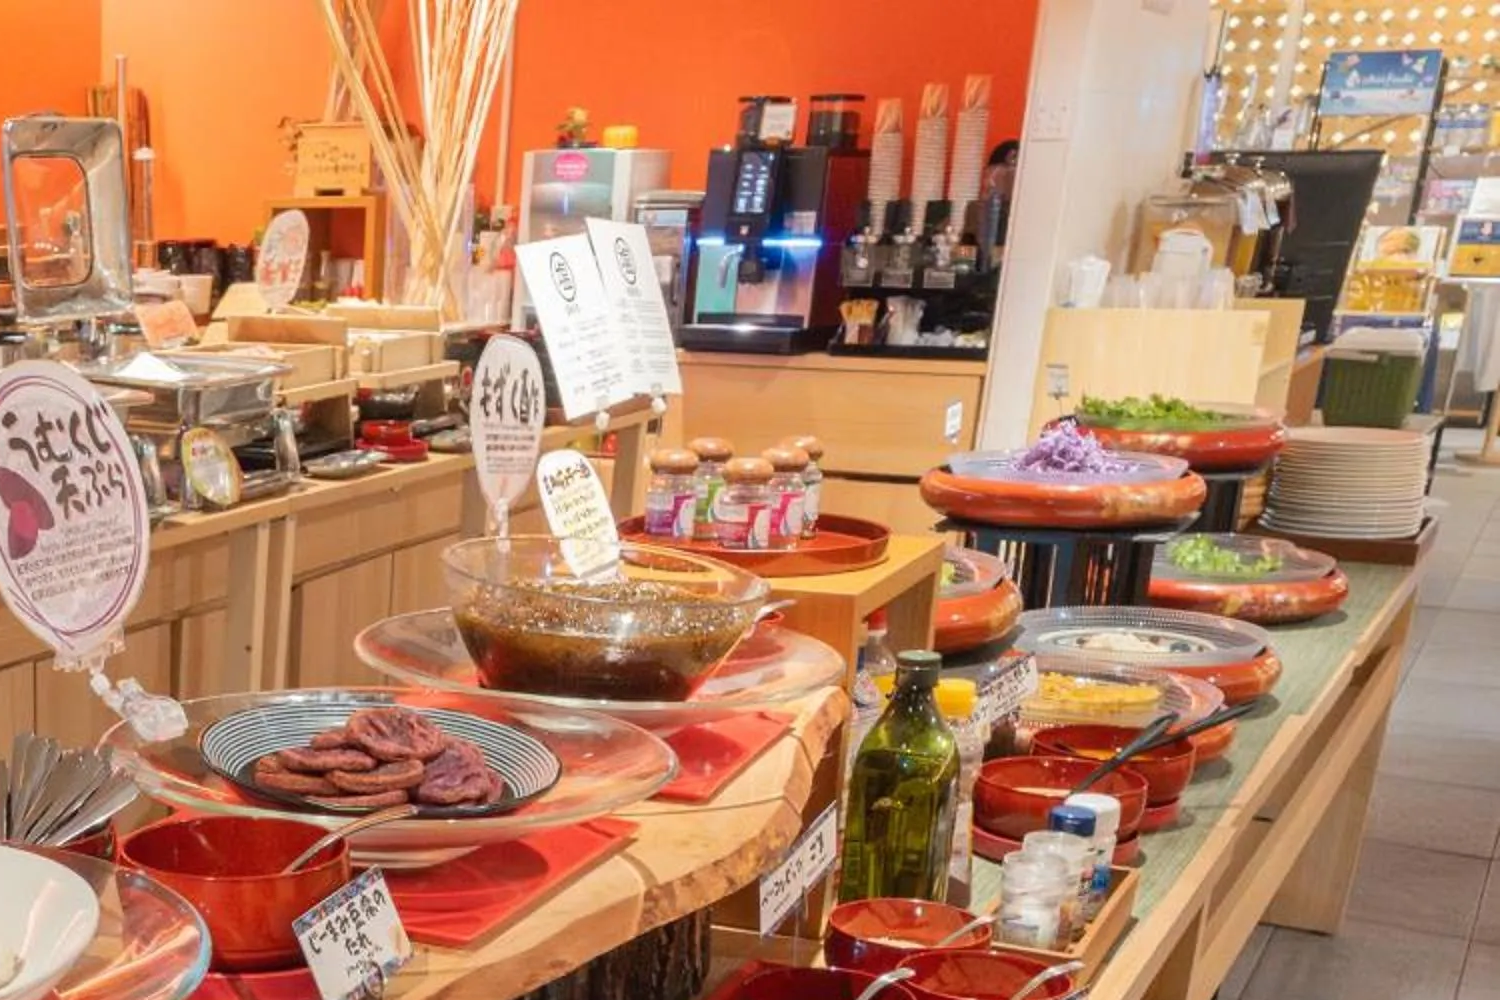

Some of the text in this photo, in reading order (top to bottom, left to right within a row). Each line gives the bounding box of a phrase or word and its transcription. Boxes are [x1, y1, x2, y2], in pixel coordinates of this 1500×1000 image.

[1, 401, 111, 473] うむくじ
[51, 459, 126, 520] 天ぷら
